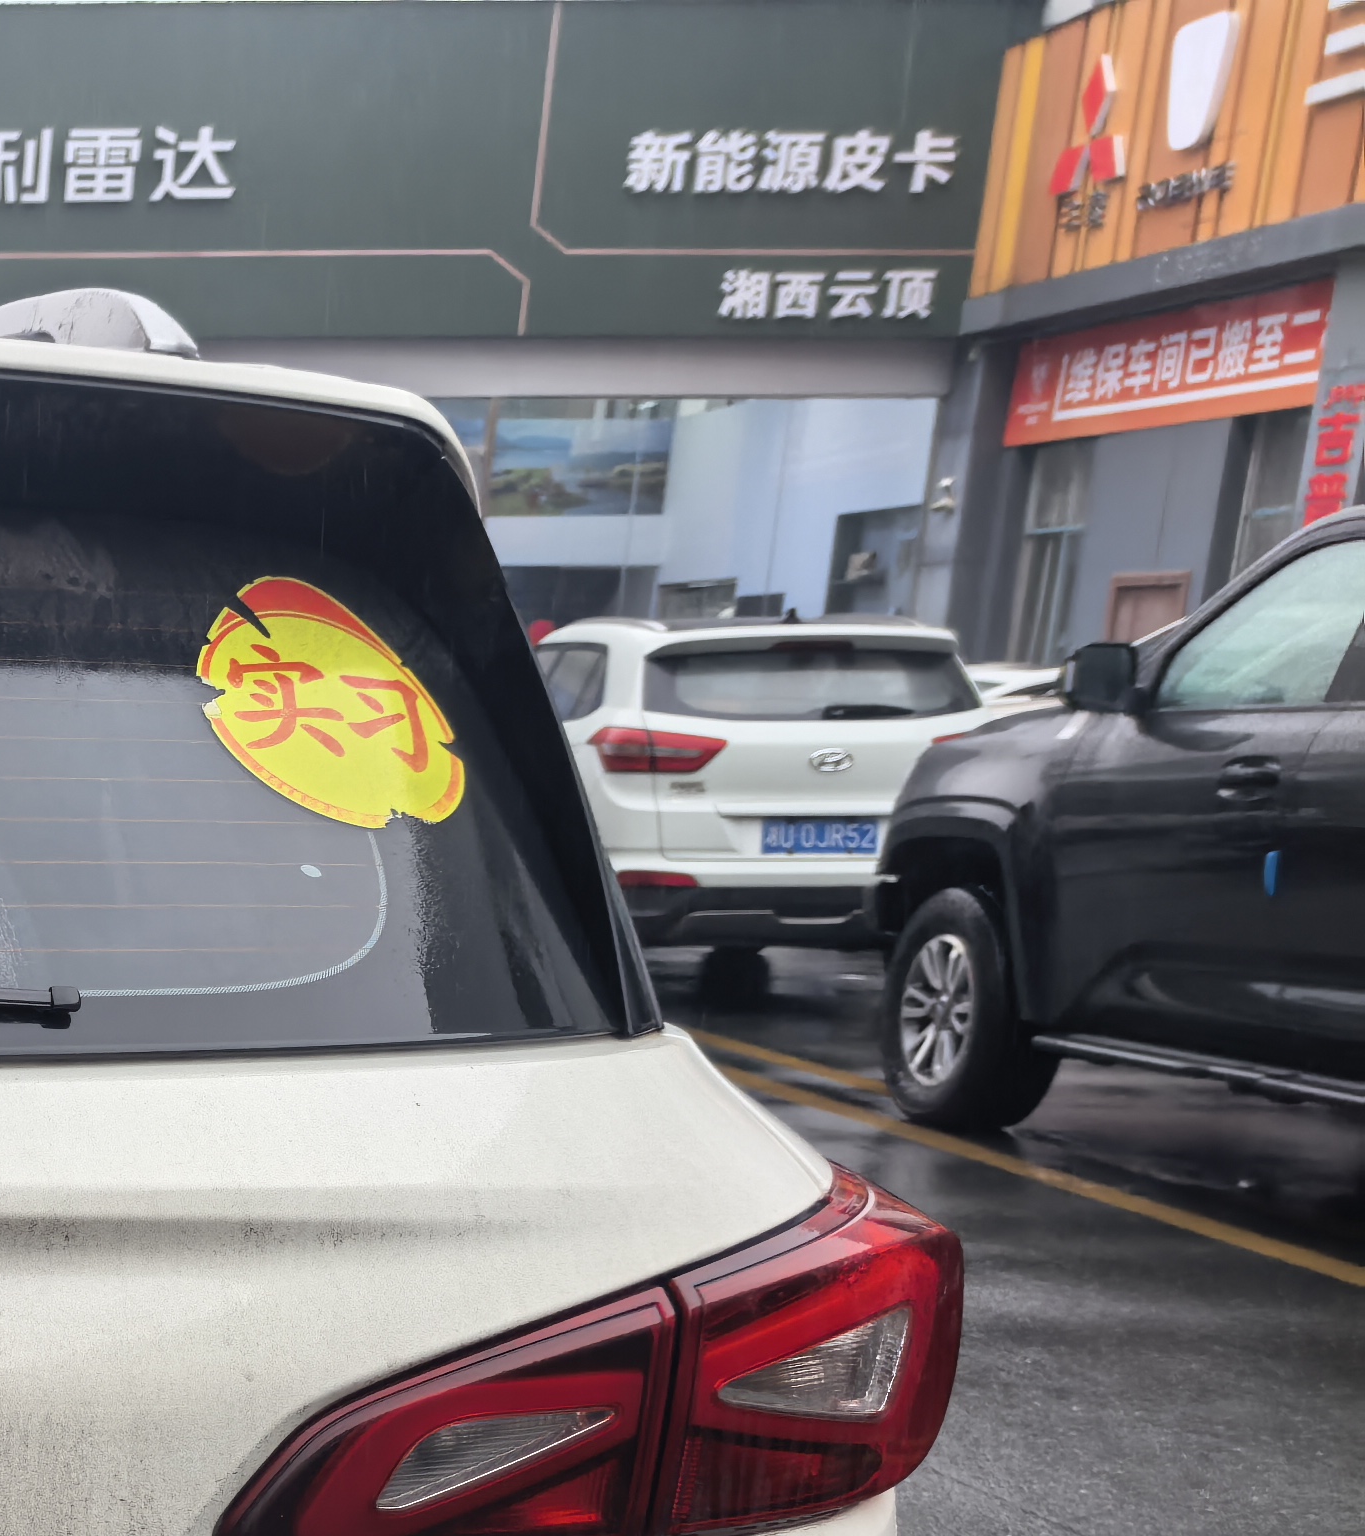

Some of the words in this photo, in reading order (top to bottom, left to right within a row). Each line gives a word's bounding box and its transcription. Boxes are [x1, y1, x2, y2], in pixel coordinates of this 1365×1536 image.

[623, 128, 961, 195] 新能源皮卡
[717, 268, 940, 320] 湘西云顶
[1064, 309, 1321, 404] 维保车间已搬至二
[227, 643, 430, 774] 实习
